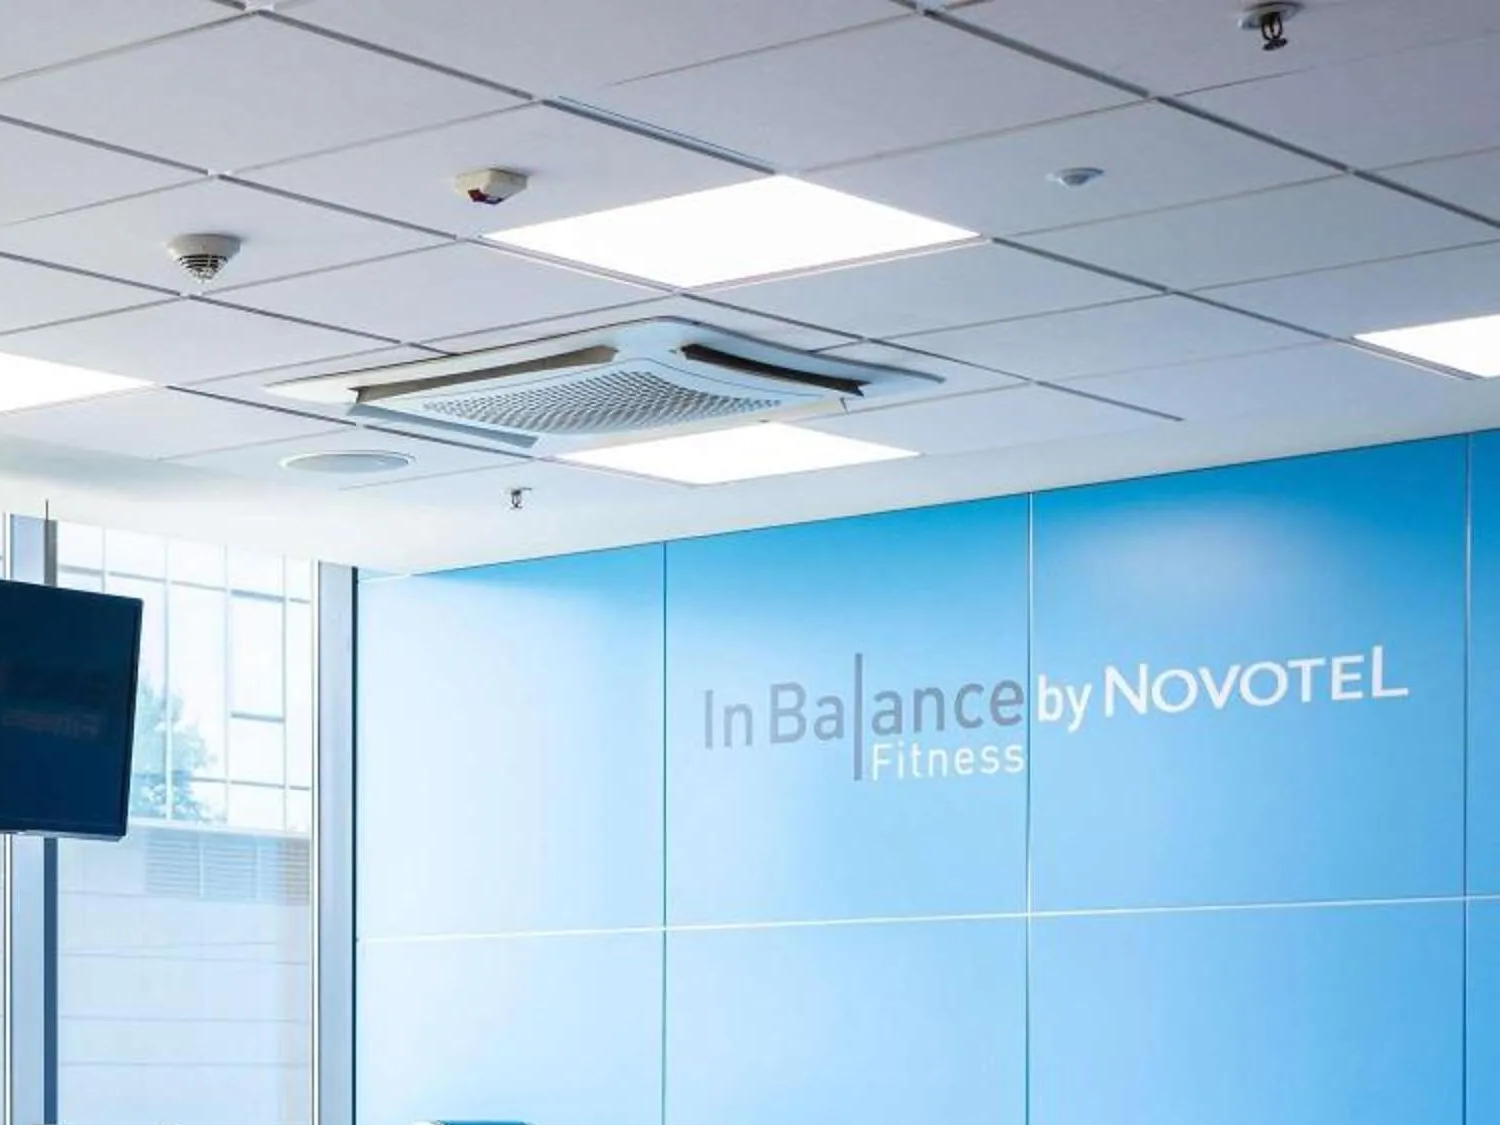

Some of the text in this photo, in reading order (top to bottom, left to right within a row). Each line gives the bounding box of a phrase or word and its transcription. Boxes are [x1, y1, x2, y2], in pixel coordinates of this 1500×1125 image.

[704, 645, 1409, 782] In Balance by NOVOTEL
[872, 742, 1025, 782] Fitness
